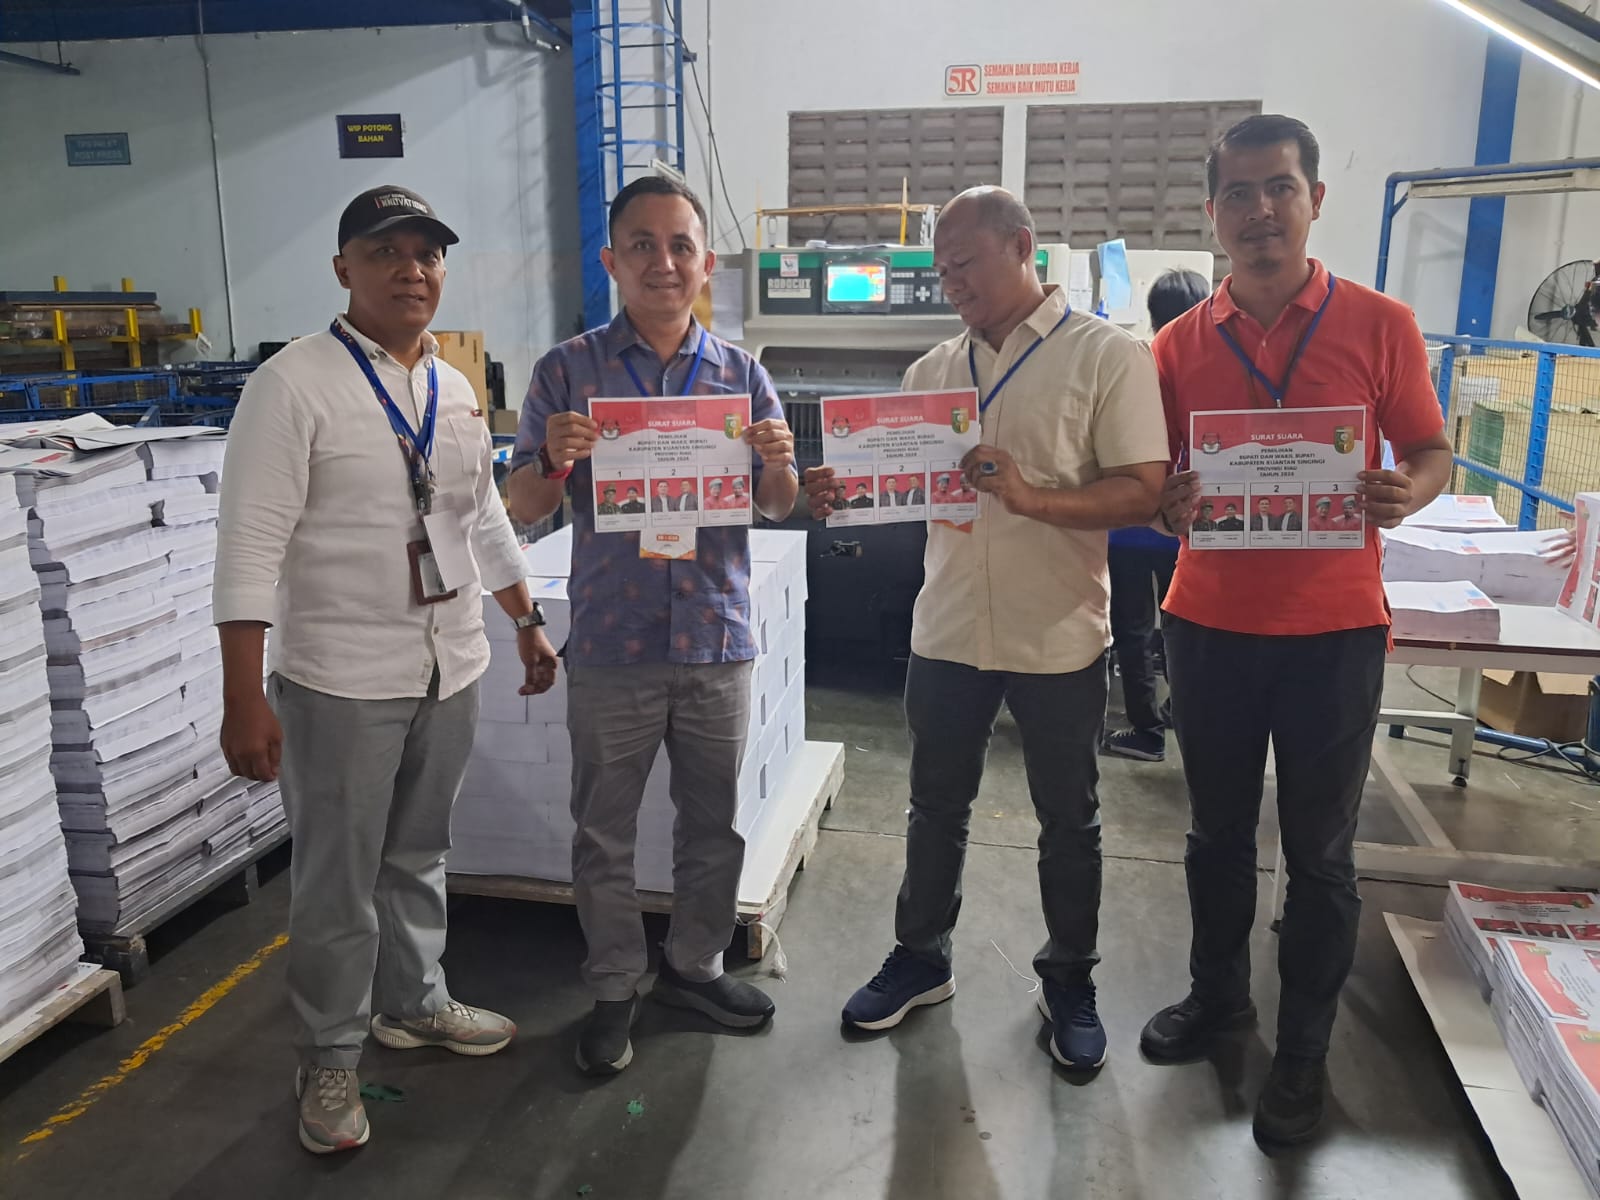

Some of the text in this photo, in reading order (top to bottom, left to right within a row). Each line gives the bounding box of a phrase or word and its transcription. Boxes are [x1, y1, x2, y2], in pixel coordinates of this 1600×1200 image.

[984, 61, 1080, 76] SEMAKIN BAIK BUDAYA KERJA
[947, 67, 977, 93] 5R
[986, 79, 1076, 94] SEMAKIN BAIK MUTU KERJA
[346, 123, 393, 132] WIP POTONG
[357, 134, 384, 142] BAHAN
[647, 420, 670, 428] SURAT
[877, 416, 898, 424] SURAT
[1216, 484, 1338, 494] 1 2 3
